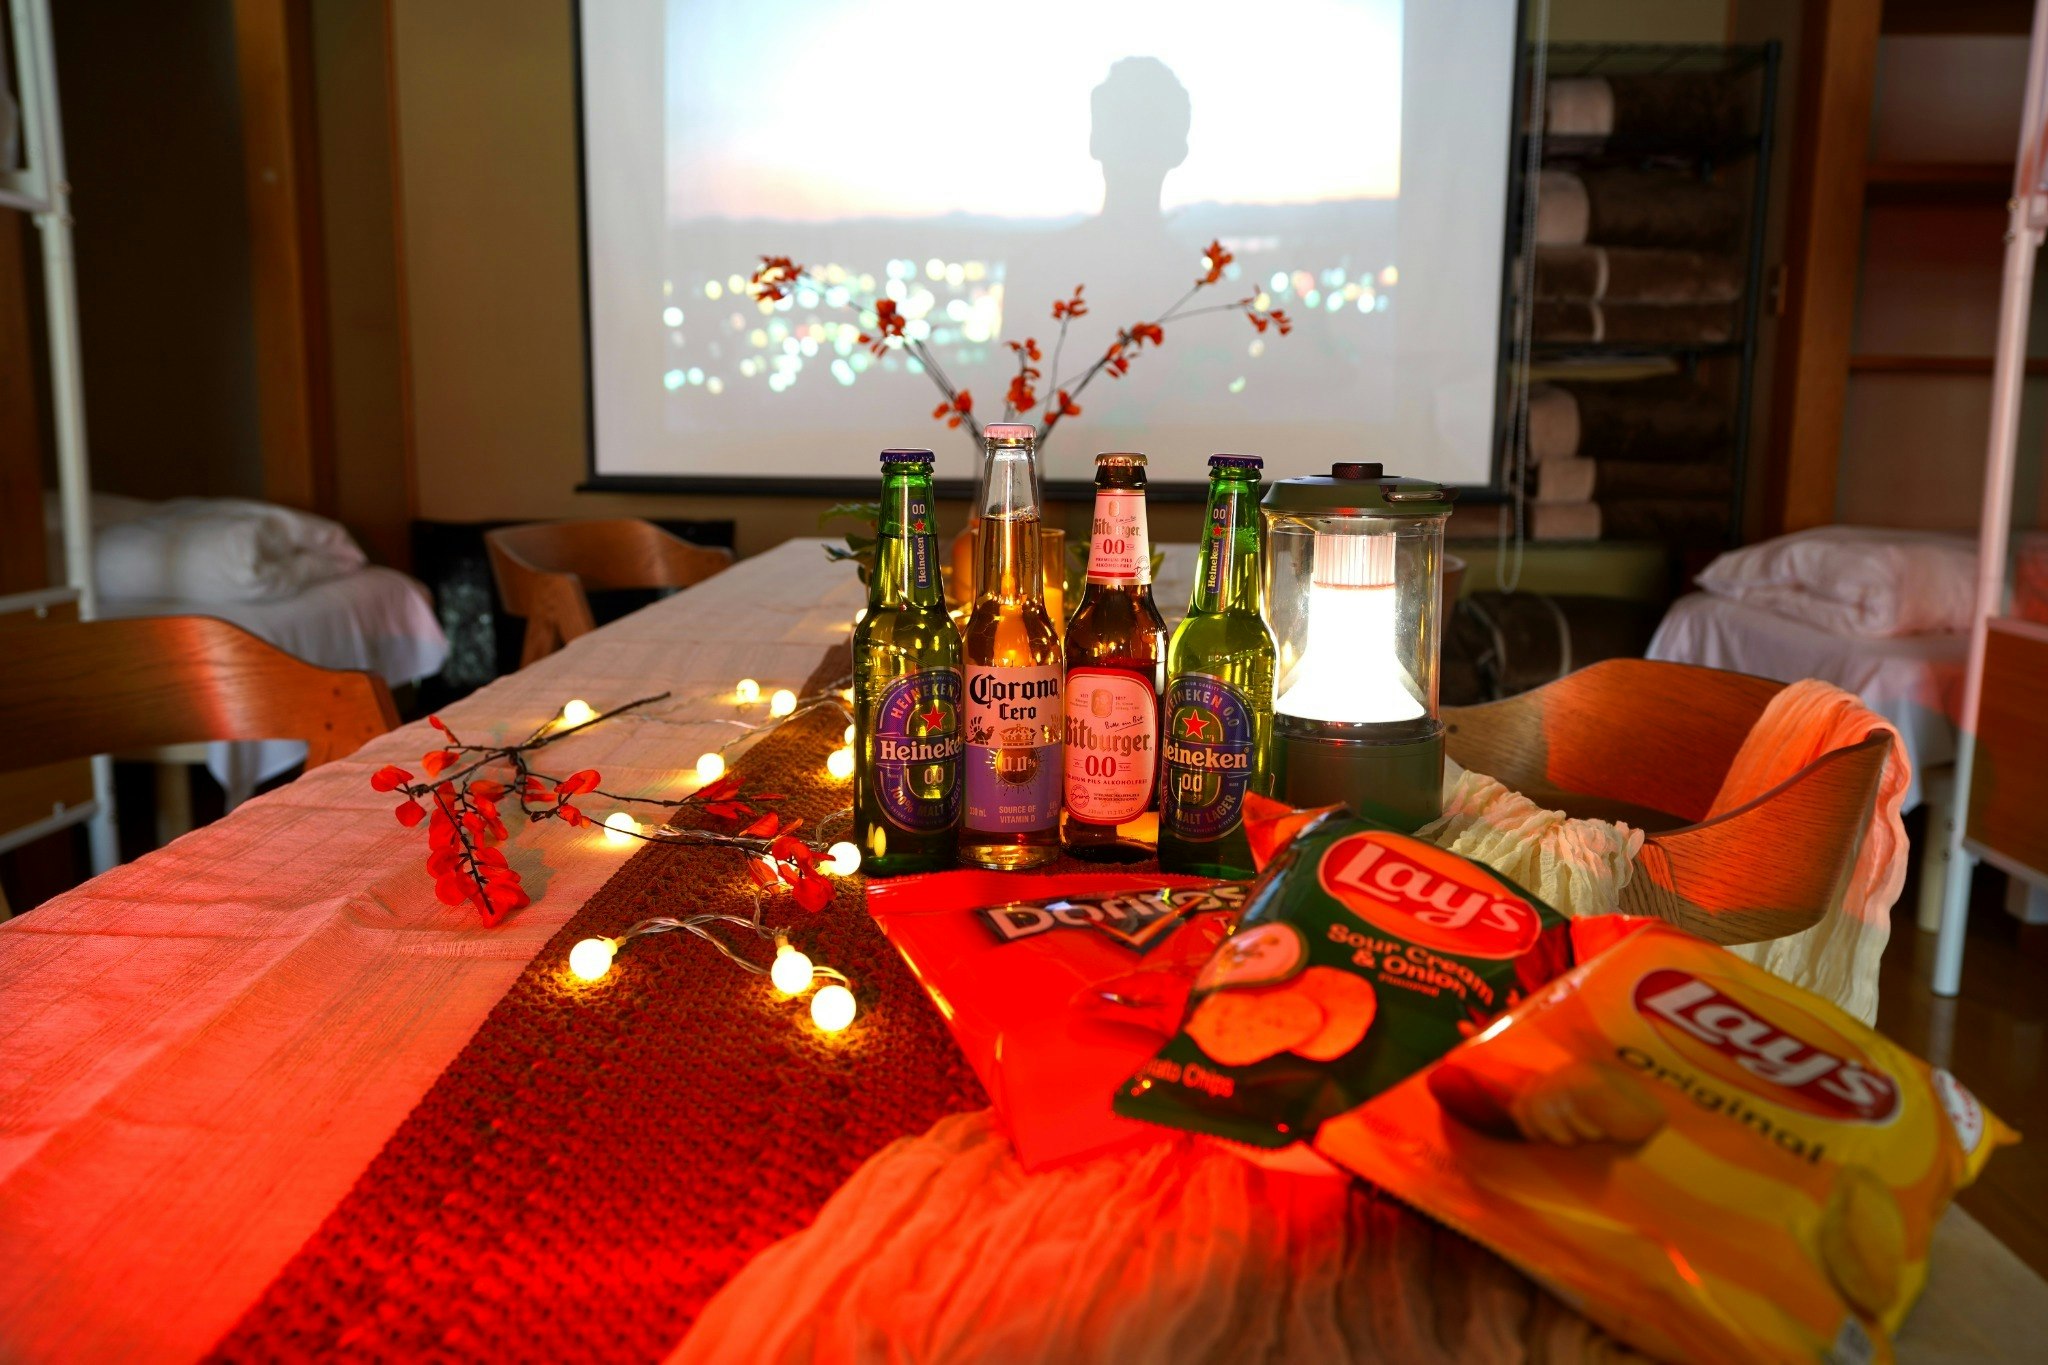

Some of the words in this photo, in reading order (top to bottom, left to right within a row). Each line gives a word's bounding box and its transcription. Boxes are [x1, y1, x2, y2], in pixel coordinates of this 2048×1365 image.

[1213, 508, 1226, 520] 0.0
[916, 536, 927, 583] Heineken
[1103, 538, 1125, 555] 0.0
[1207, 540, 1220, 588] Heineken
[890, 683, 956, 719] HEINEKEN
[969, 673, 1059, 709] Corona
[1166, 688, 1223, 718] HEINEKEN
[1222, 706, 1240, 727] 0.0
[999, 702, 1037, 720] Cero
[880, 737, 963, 761] Heineke
[1085, 755, 1117, 778] 0.0
[1162, 739, 1248, 769] Heineken
[1181, 773, 1203, 793] 0.0
[998, 805, 1026, 814] SOURCE
[1027, 804, 1037, 813] OF
[1000, 815, 1029, 824] VITAMIN
[1030, 814, 1036, 823] D
[1205, 794, 1237, 823] LAGER
[1334, 841, 1528, 933] Lay's
[987, 886, 1247, 940] Doritos
[1327, 922, 1401, 954] Sour
[1404, 944, 1495, 1007] Cream
[1351, 949, 1377, 969] &
[1382, 954, 1468, 1000] Onion
[1643, 978, 1892, 1107] Lay's
[1615, 1046, 1825, 1165] Original
